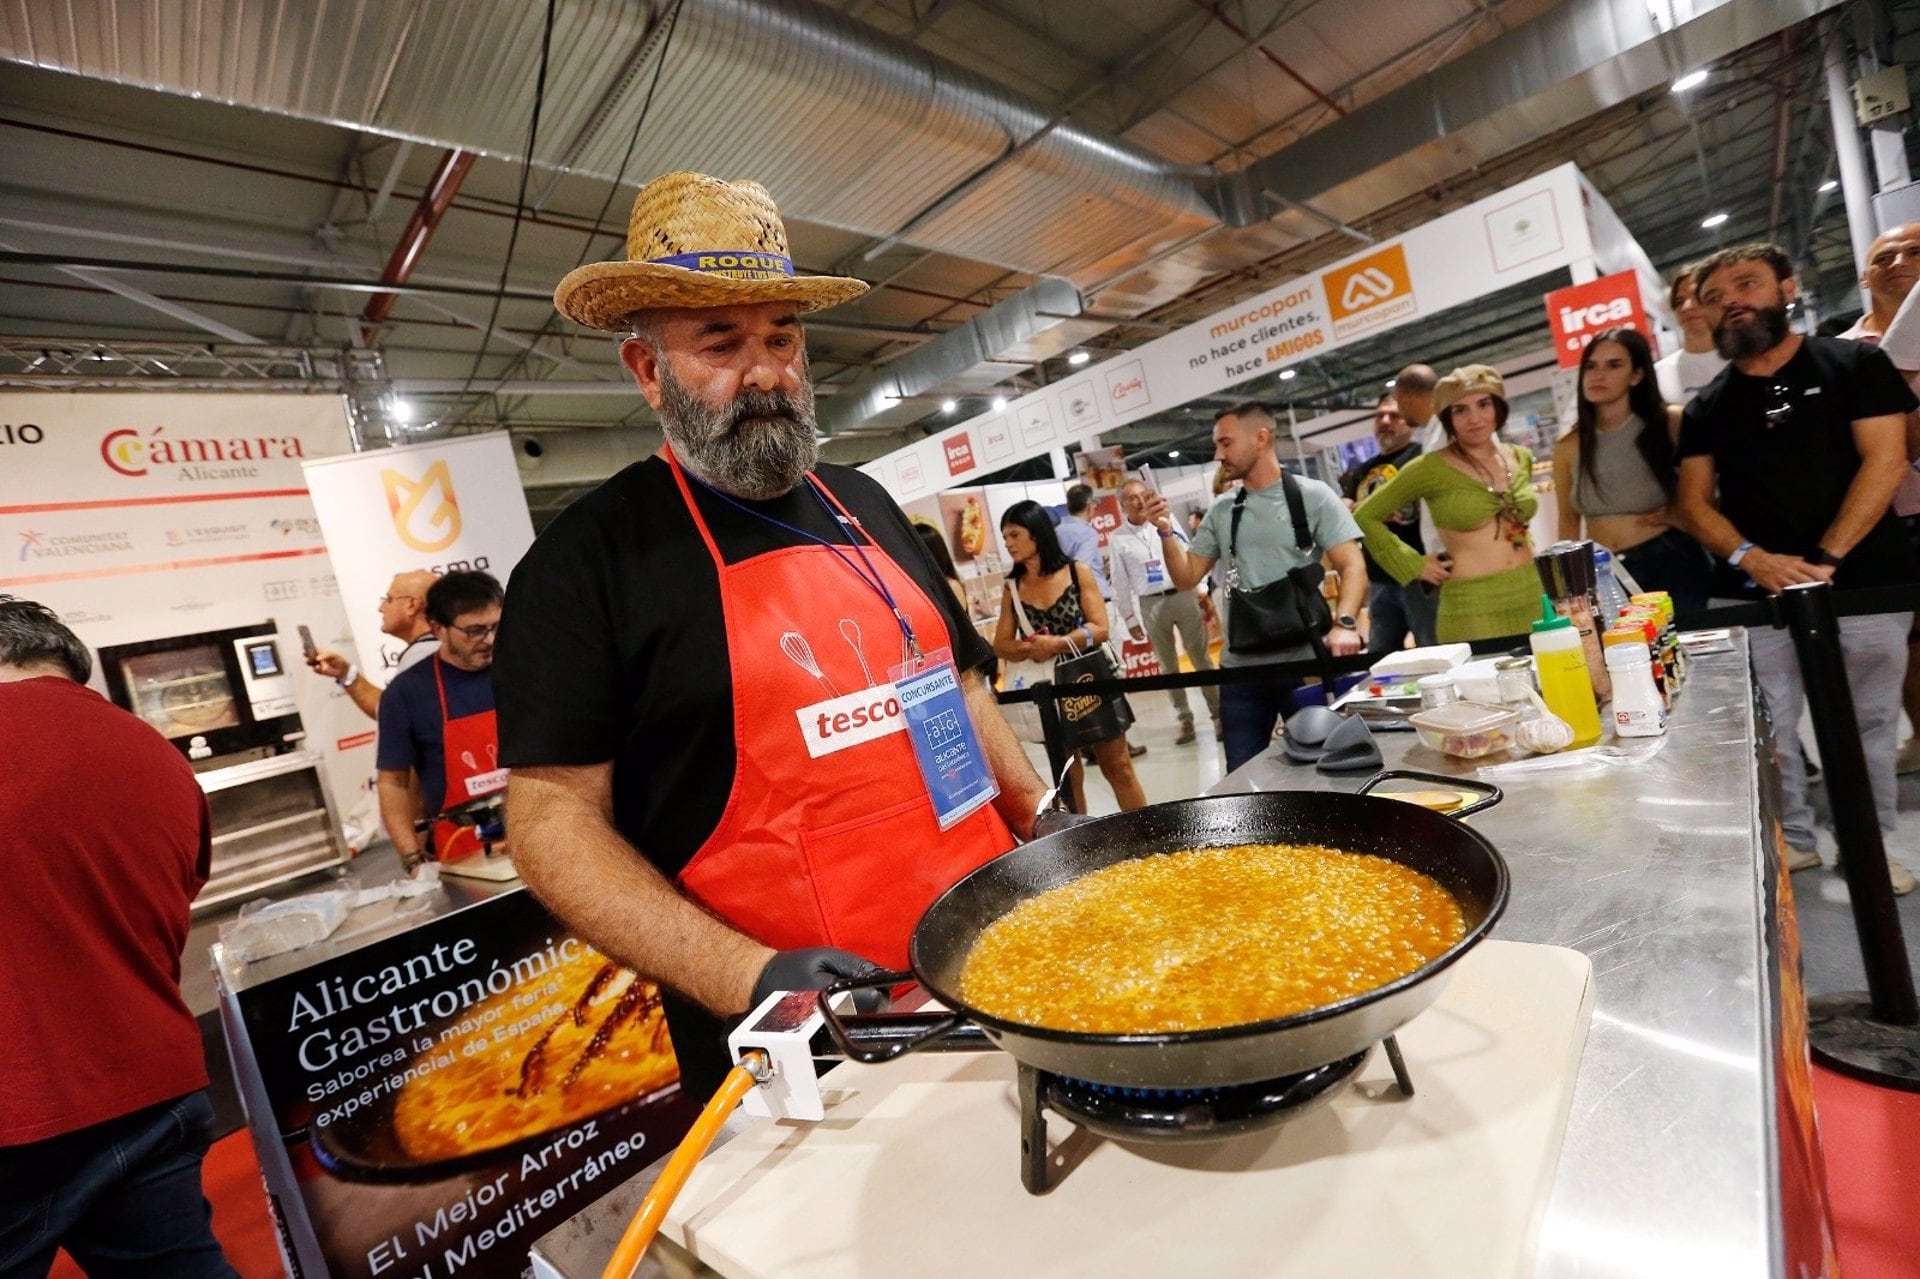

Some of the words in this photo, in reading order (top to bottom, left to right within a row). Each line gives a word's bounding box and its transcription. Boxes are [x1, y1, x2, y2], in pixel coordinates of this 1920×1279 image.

[699, 256, 785, 272] ROQUE
[1210, 287, 1312, 339] murcopan
[1337, 299, 1411, 334] murcopan
[1560, 297, 1633, 334] irca
[1189, 354, 1209, 369] no
[1210, 337, 1247, 360] hace
[1250, 310, 1321, 345] clientes,
[1225, 356, 1263, 378] hace
[1266, 328, 1324, 363] AMIGOS
[0, 423, 44, 445] IO
[101, 426, 305, 477] Cámara
[177, 465, 260, 483] Alicante
[34, 541, 134, 559] VALENCIANA
[901, 674, 954, 704] CONCURSANTE
[287, 937, 478, 1032] Alicante
[299, 936, 598, 1072] Gastronómic
[306, 1047, 407, 1102] Saborea
[412, 1032, 434, 1052] la
[439, 1003, 505, 1042] mayor
[512, 981, 559, 1011] feria
[316, 1048, 456, 1128] experiencial
[462, 1035, 488, 1058] de
[367, 1233, 407, 1276] El
[415, 1172, 509, 1247] Mejor
[519, 1119, 600, 1183] Arroz
[444, 1130, 648, 1275] Mediterráneo
